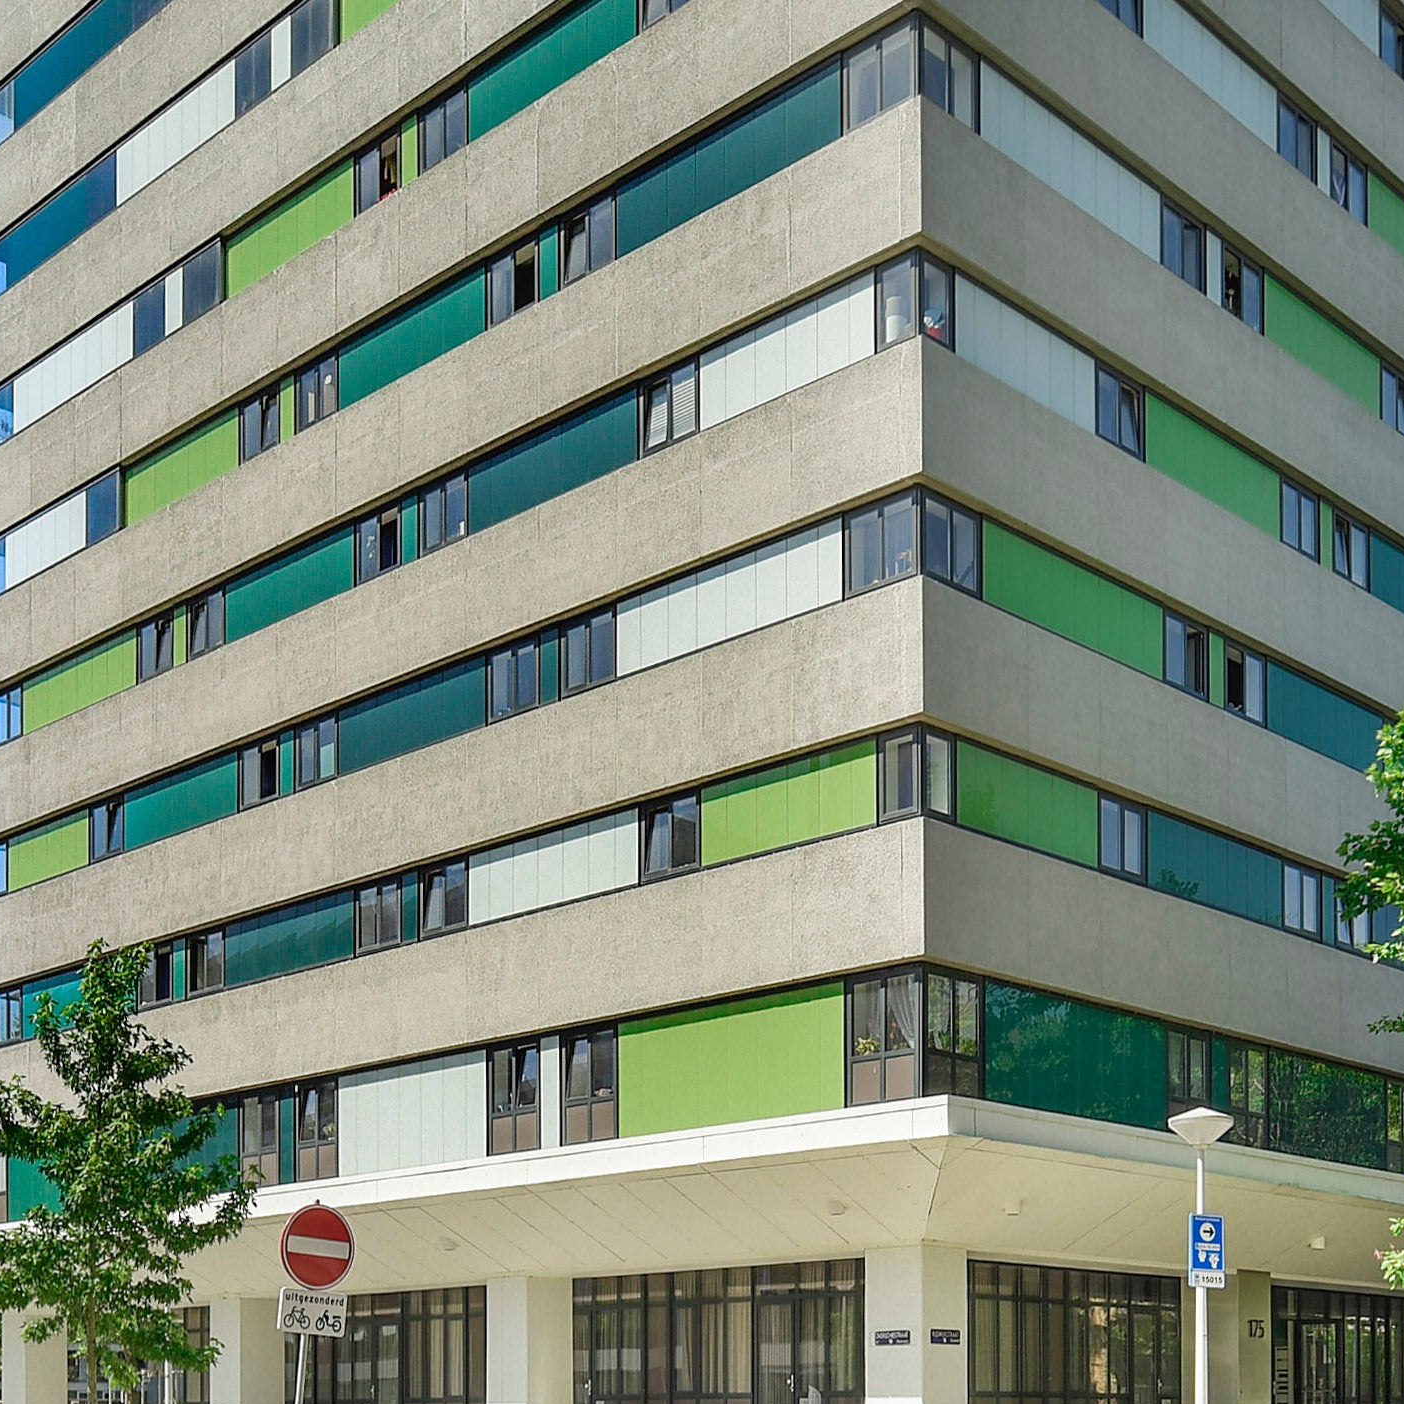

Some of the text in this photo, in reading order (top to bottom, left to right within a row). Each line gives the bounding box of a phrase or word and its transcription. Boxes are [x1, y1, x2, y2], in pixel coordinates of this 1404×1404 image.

[1201, 1275, 1223, 1284] 15015
[285, 1291, 345, 1307] uitgezonderd
[1246, 1319, 1265, 1339] 175
